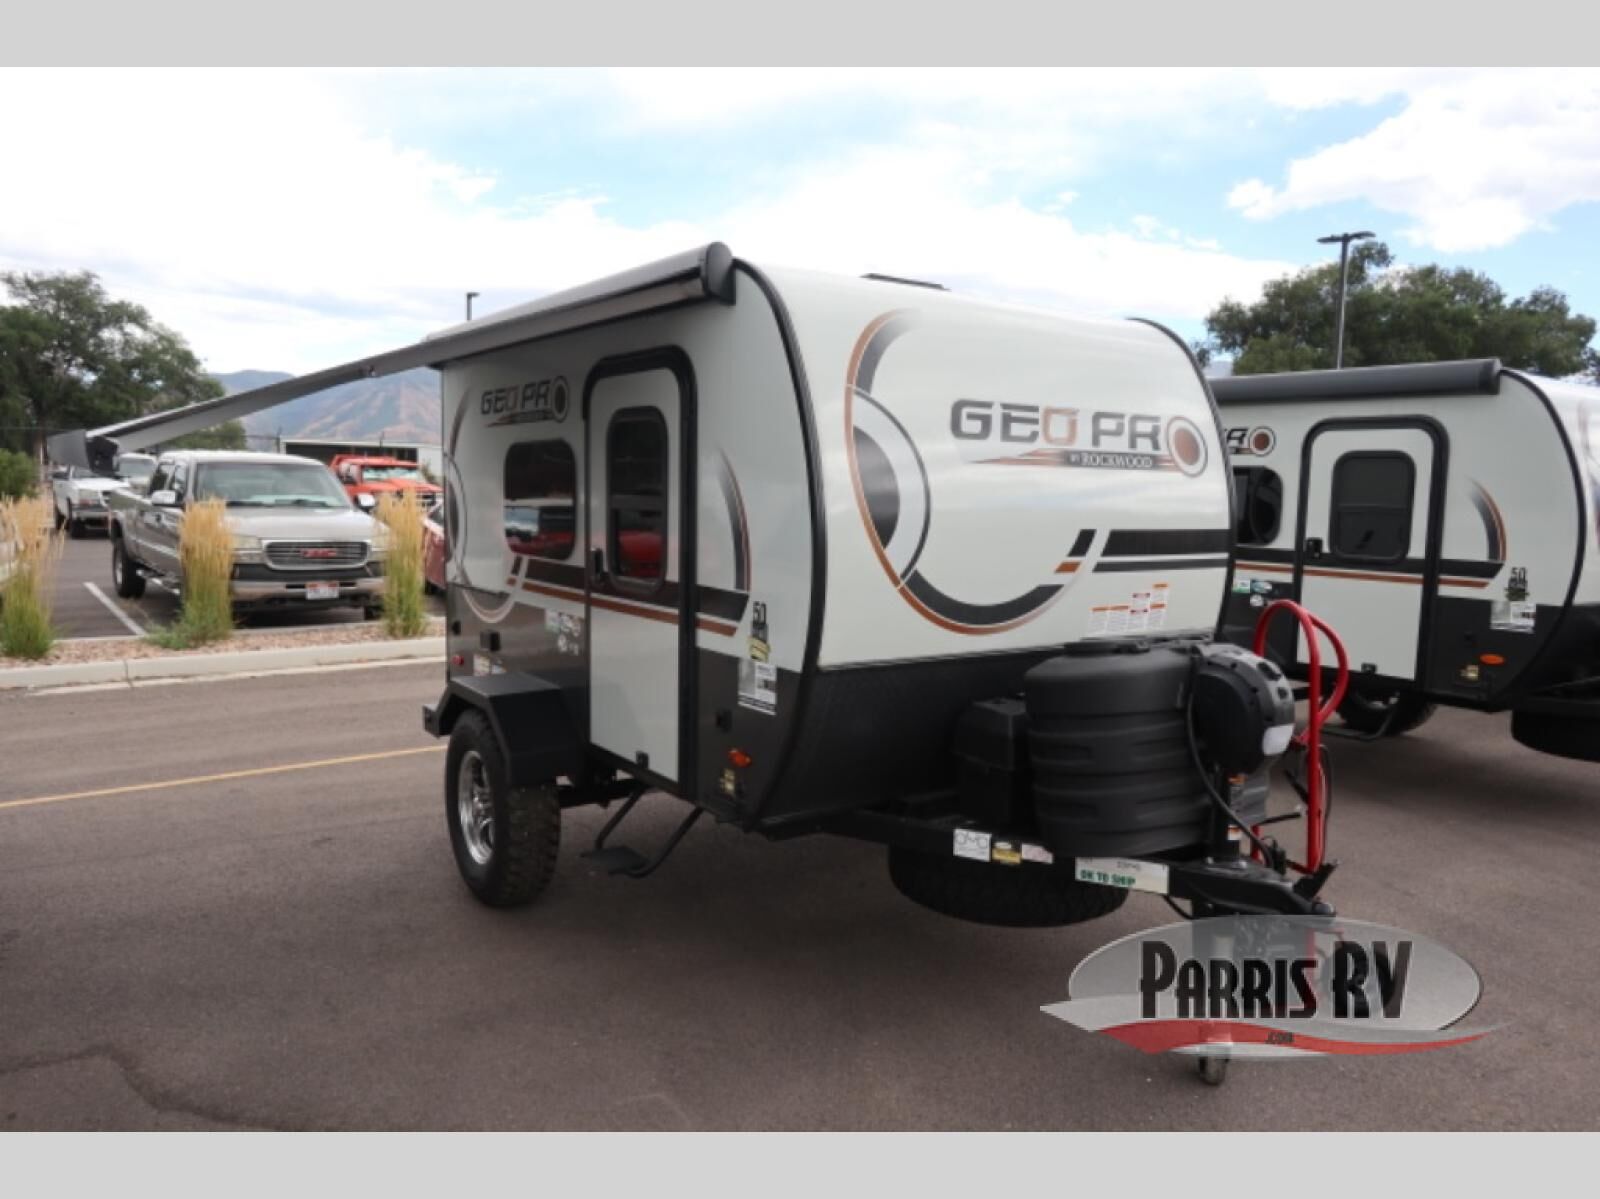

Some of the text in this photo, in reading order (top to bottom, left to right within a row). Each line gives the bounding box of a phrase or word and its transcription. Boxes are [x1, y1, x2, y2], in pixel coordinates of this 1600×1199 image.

[481, 375, 570, 424] GEO PRO
[950, 399, 1208, 478] GEO PRO
[1223, 425, 1277, 458] RO
[1081, 452, 1153, 469] ROCKWOOD
